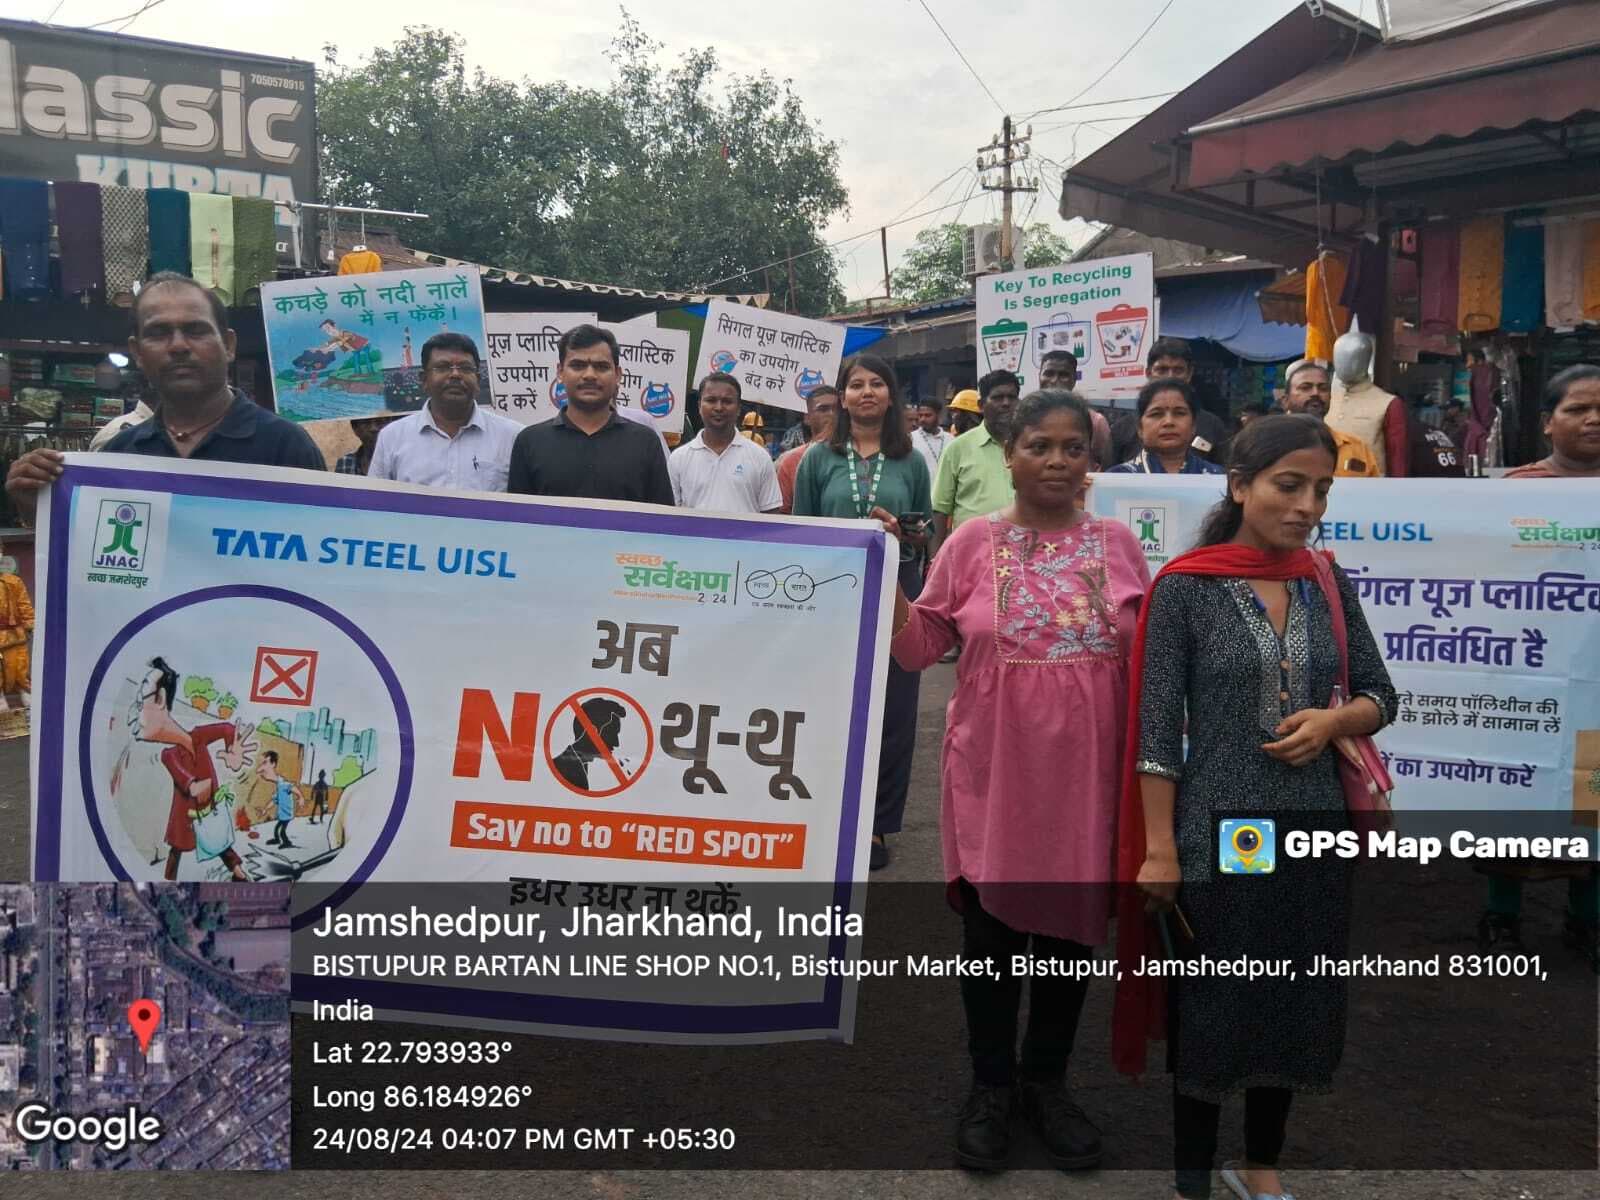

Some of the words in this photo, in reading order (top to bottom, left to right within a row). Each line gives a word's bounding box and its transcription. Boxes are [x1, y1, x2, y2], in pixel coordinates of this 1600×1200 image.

[337, 283, 367, 308] को
[376, 279, 416, 304] नदी
[425, 274, 469, 300] नालें
[994, 280, 1024, 294] Key
[1028, 276, 1047, 289] To
[1051, 265, 1132, 286] Recycling
[1004, 298, 1017, 311] Is
[1023, 286, 1122, 310] Segregation
[359, 309, 376, 326] में
[384, 311, 400, 325] न
[717, 313, 754, 339] सिंगल
[781, 330, 832, 355] प्लास्टिक
[496, 360, 549, 383] उपयोग
[739, 350, 756, 365] का
[759, 353, 800, 373] उपयोग
[744, 371, 763, 390] बंद
[765, 375, 786, 393] करें
[512, 387, 538, 410] करें
[1372, 522, 1433, 541] UISL
[96, 554, 139, 569] JNAC
[212, 528, 308, 562] TATA
[318, 537, 426, 572] STEEL
[437, 547, 517, 579] UISL
[623, 560, 732, 593] सर्वेक्षण
[1420, 579, 1476, 618] यूज
[592, 619, 679, 676] अब
[1384, 624, 1518, 666] प्रतिबंधित
[1522, 628, 1548, 668] है
[1417, 694, 1457, 709] समय
[1461, 693, 1532, 714] पॉलिथीन
[1536, 698, 1559, 715] की
[1401, 707, 1418, 724] के
[1422, 709, 1458, 727] झोले
[1463, 711, 1480, 729] में
[1483, 717, 1540, 733] सामान
[1544, 716, 1561, 734] लें
[659, 702, 812, 801] थू-थू
[1395, 758, 1423, 778] का
[1427, 759, 1494, 784] उपयोग
[1498, 763, 1537, 788] करें
[468, 813, 525, 848] Say
[533, 817, 569, 846] no
[580, 821, 612, 849] to
[509, 876, 571, 906] इधर
[577, 882, 637, 911] उधर
